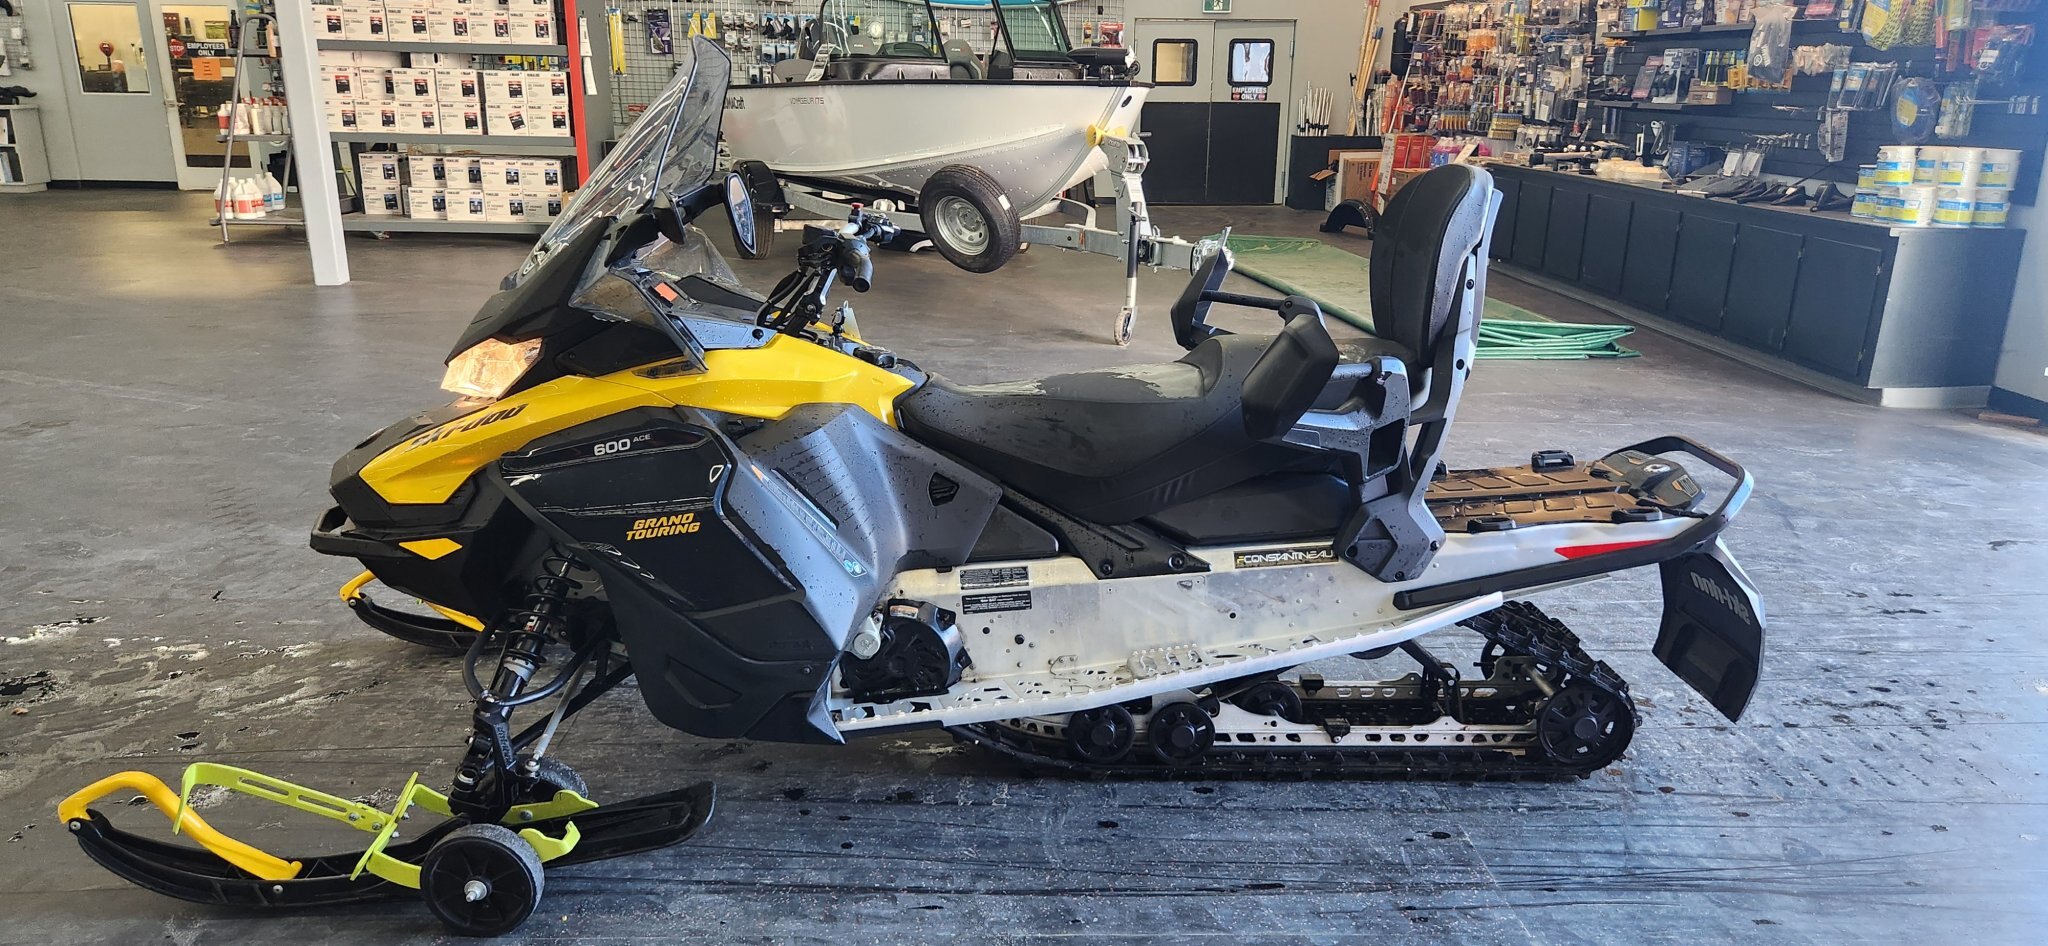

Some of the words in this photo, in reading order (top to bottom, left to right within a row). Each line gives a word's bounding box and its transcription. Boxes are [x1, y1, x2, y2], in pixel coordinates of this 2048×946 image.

[186, 42, 225, 50] EMPLOYEES
[594, 438, 631, 456] 600
[633, 433, 652, 443] ACE
[633, 512, 695, 531] GRAND
[626, 522, 701, 541] TOURING
